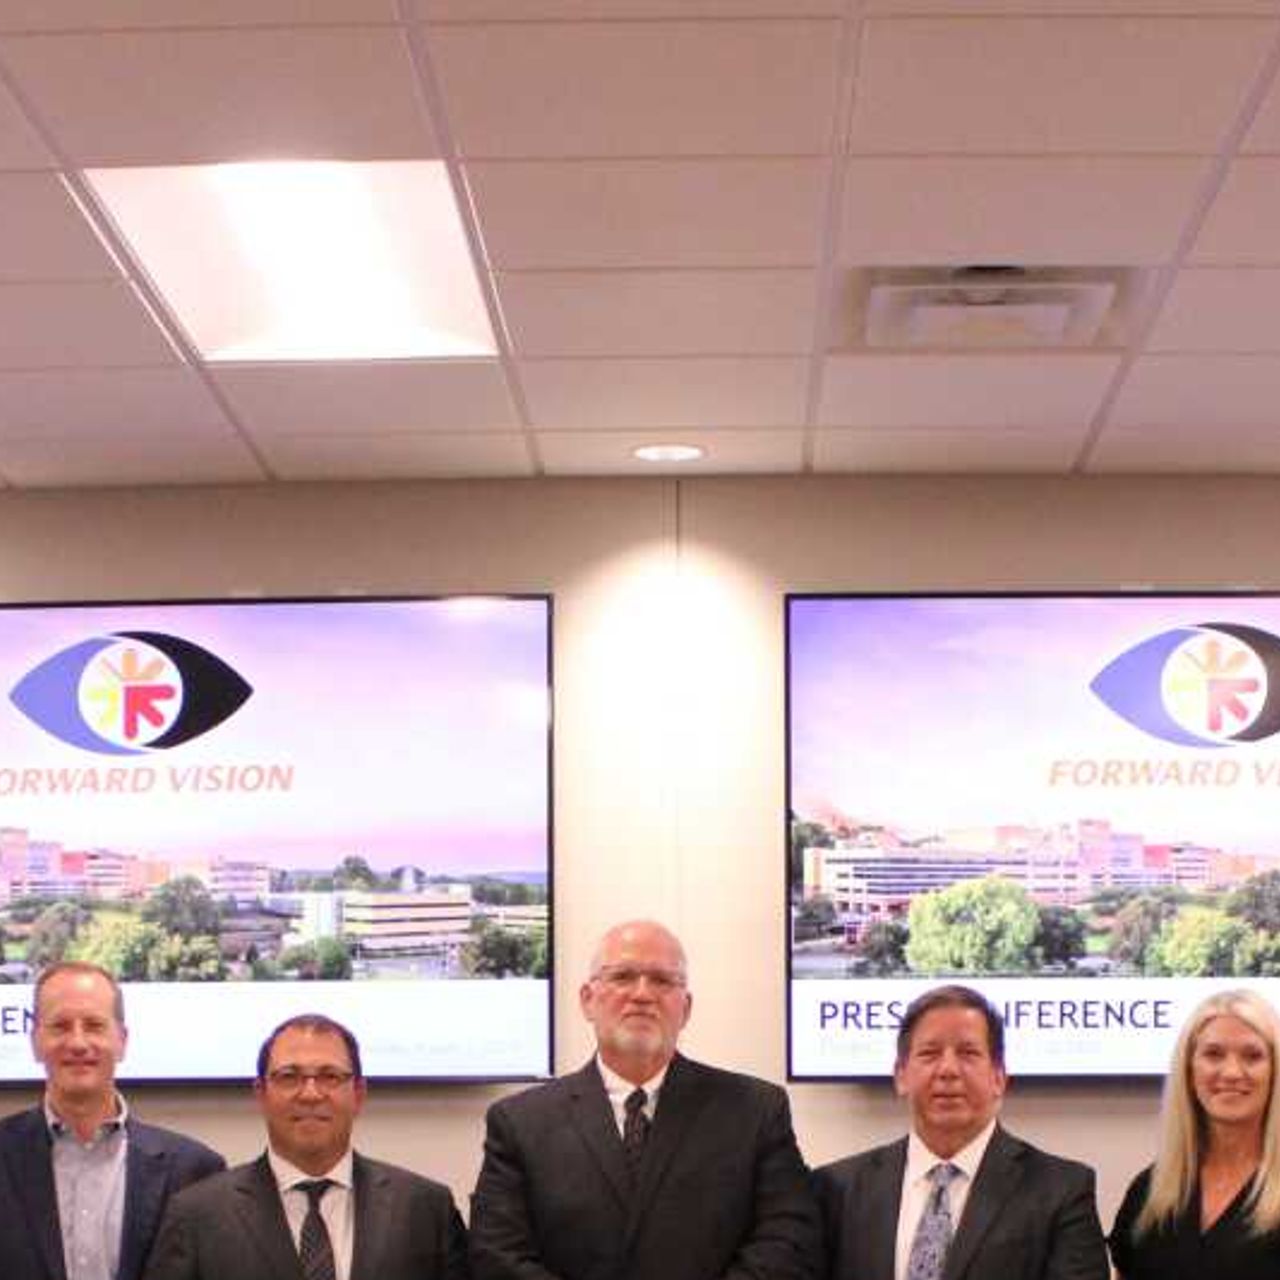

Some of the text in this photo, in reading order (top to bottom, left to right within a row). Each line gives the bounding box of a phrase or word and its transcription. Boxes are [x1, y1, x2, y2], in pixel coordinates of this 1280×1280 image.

[169, 764, 295, 793] VISION
[1048, 759, 1241, 788] FORWARD
[819, 1000, 1172, 1030] PRES FERENCE
